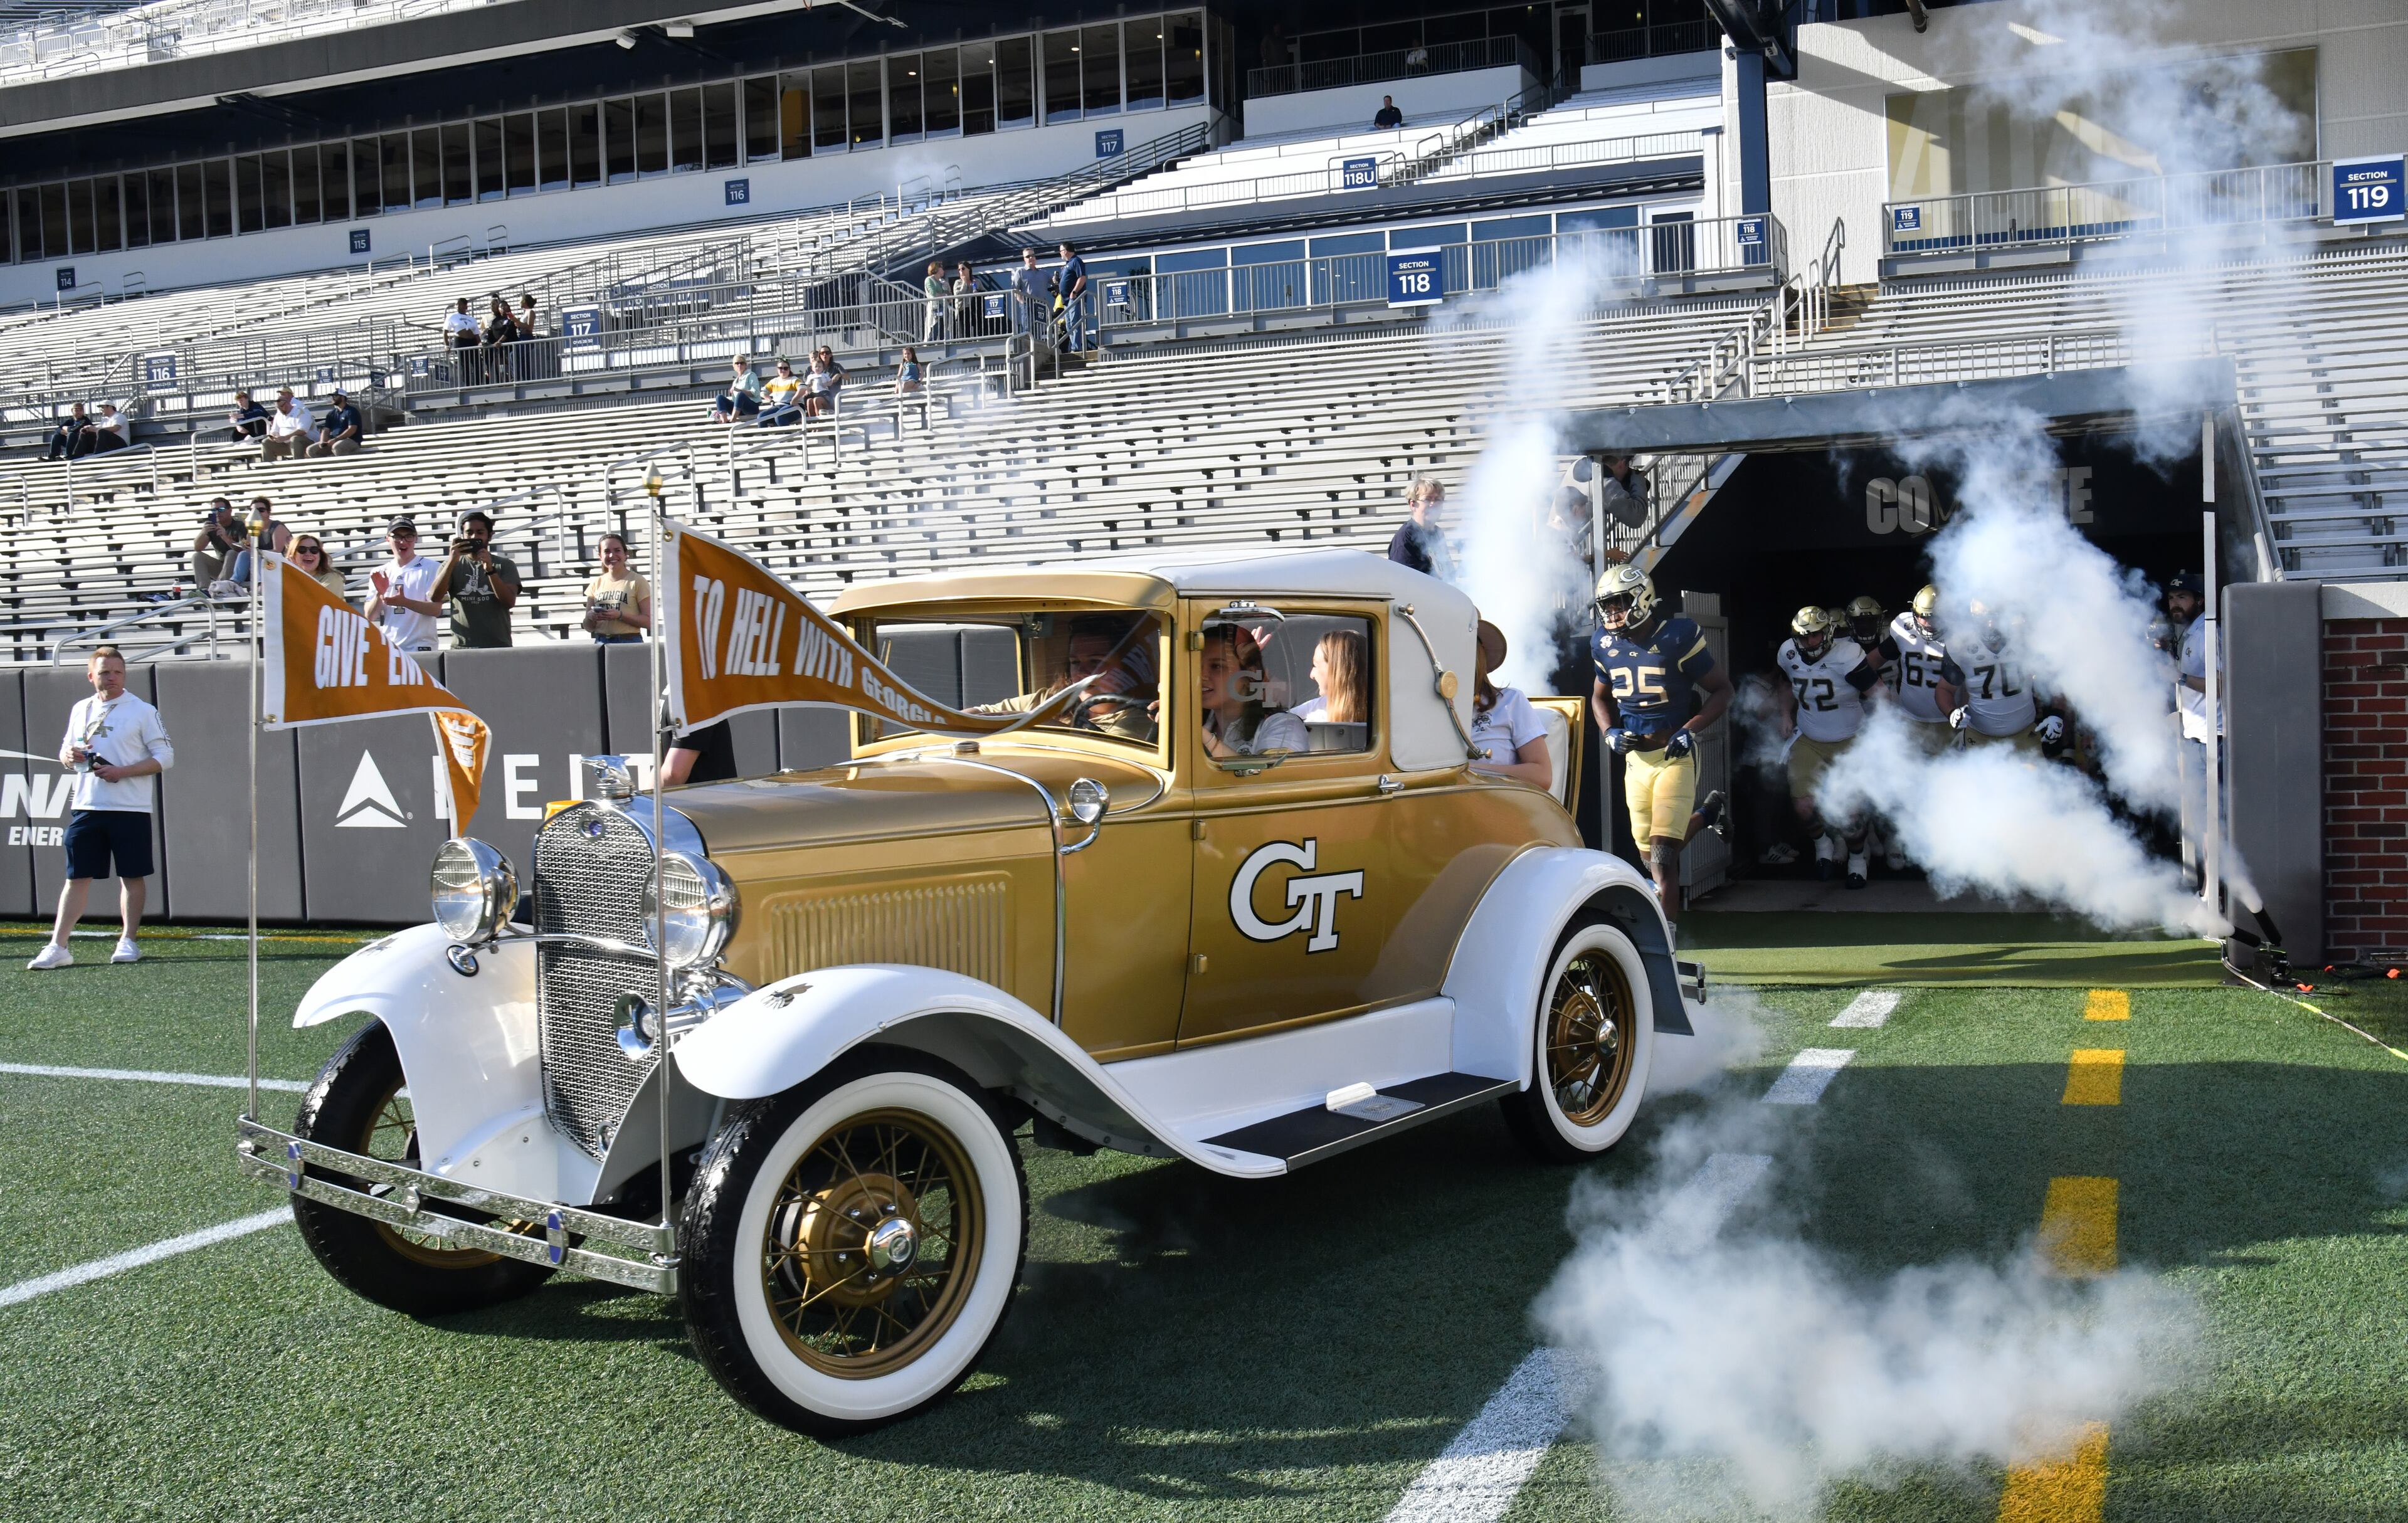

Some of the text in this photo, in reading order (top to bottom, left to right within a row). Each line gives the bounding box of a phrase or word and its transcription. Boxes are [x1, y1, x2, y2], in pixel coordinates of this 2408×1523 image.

[1102, 140, 1117, 152] 117
[1344, 171, 1375, 186] 118U
[2347, 171, 2388, 181] SECTION
[730, 190, 744, 201] 116
[2348, 186, 2389, 209] 119
[354, 240, 366, 249] 115
[1398, 260, 1429, 269] SECTION
[60, 278, 72, 287] 114
[1399, 273, 1430, 293] 118
[571, 322, 591, 336] 117
[152, 367, 170, 380] 116
[1620, 567, 1646, 583] GT
[693, 574, 725, 680] TO
[724, 587, 787, 677] HELL
[793, 615, 853, 688] WITH
[315, 604, 370, 690] GIVE
[1905, 651, 1945, 688] 63
[1227, 669, 1293, 708] GT
[1610, 666, 1669, 707] 25
[1792, 677, 1839, 712] 72
[8, 826, 64, 846] ENER
[1227, 836, 1365, 956] GT
